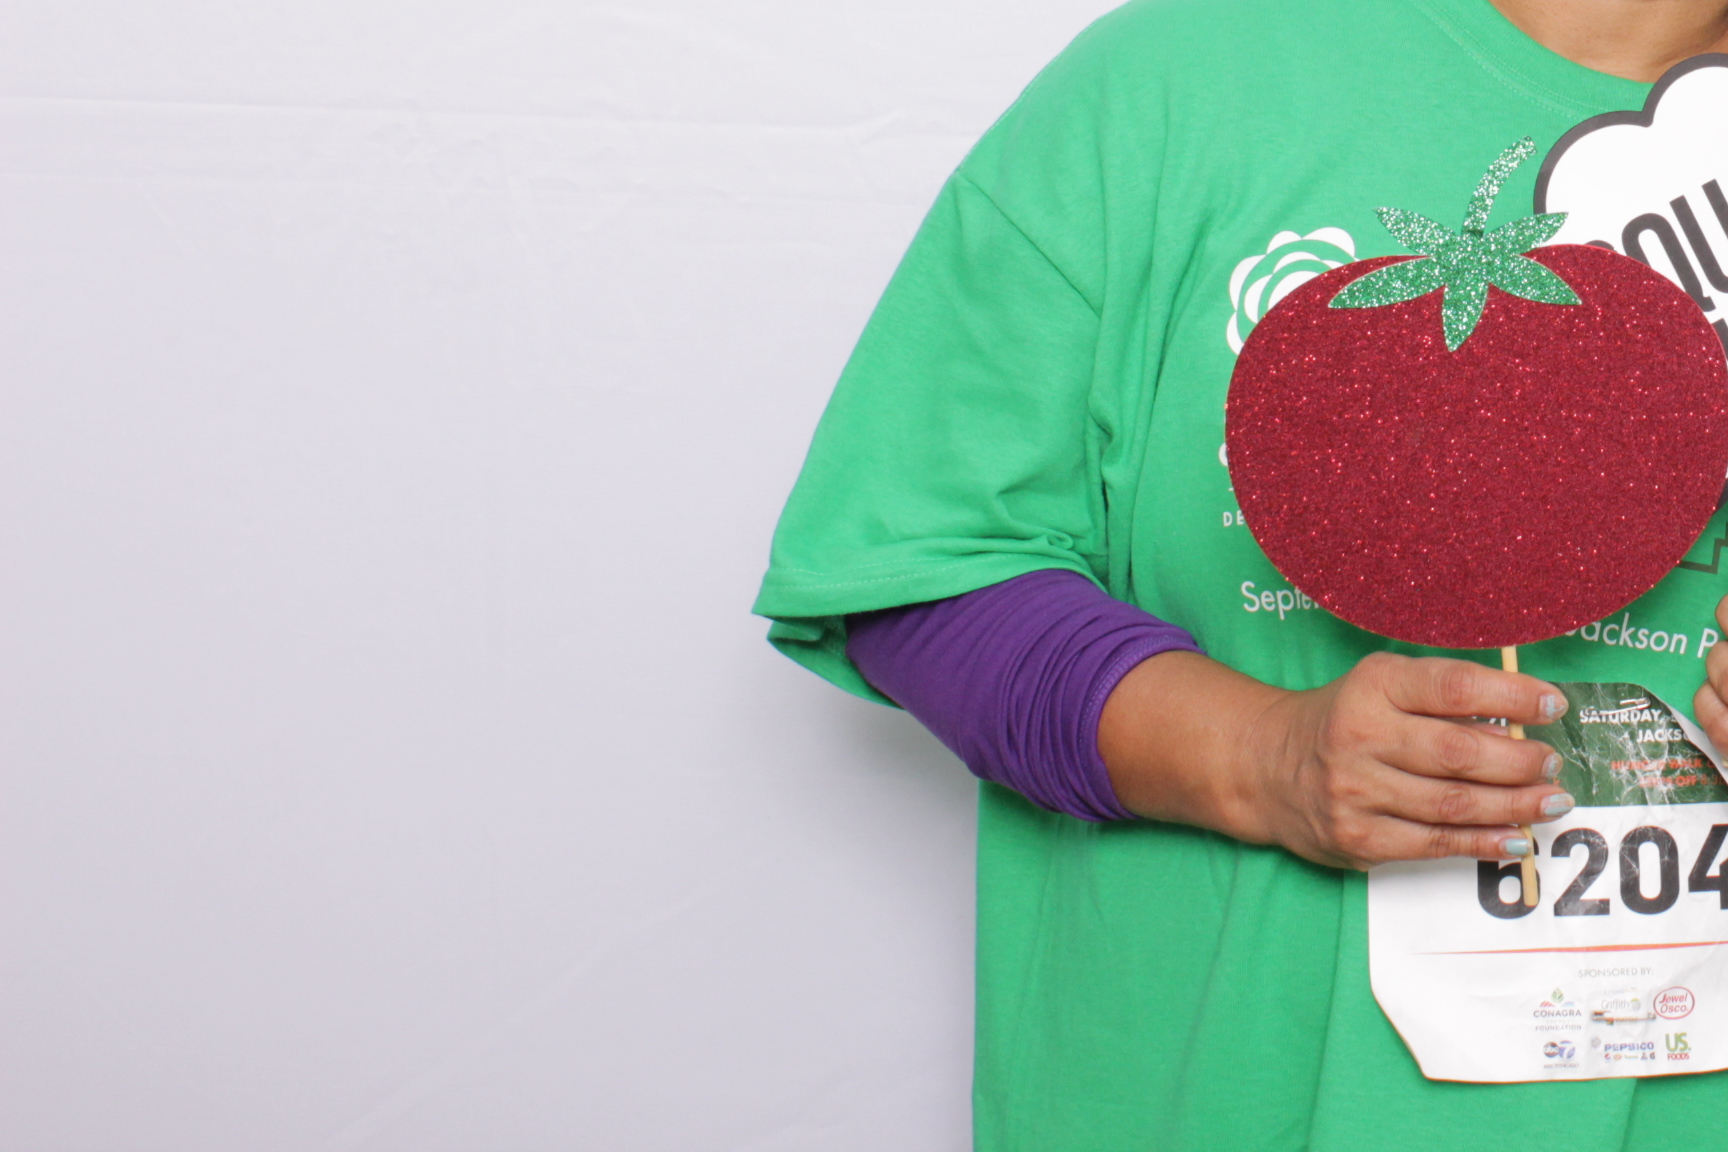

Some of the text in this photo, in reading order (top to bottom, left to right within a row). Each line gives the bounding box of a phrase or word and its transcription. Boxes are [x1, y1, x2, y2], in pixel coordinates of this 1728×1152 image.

[1565, 612, 1688, 655] ackson
[1636, 729, 1691, 742] JACKS
[1675, 774, 1698, 787] OFF
[1578, 967, 1638, 978] SPONSORED
[1659, 993, 1688, 1004] Jewel
[1601, 998, 1630, 1011] Griffith
[1533, 1009, 1582, 1018] CONAGRA
[1604, 1042, 1655, 1053] PEPSICO
[1667, 1052, 1690, 1061] FOODS
